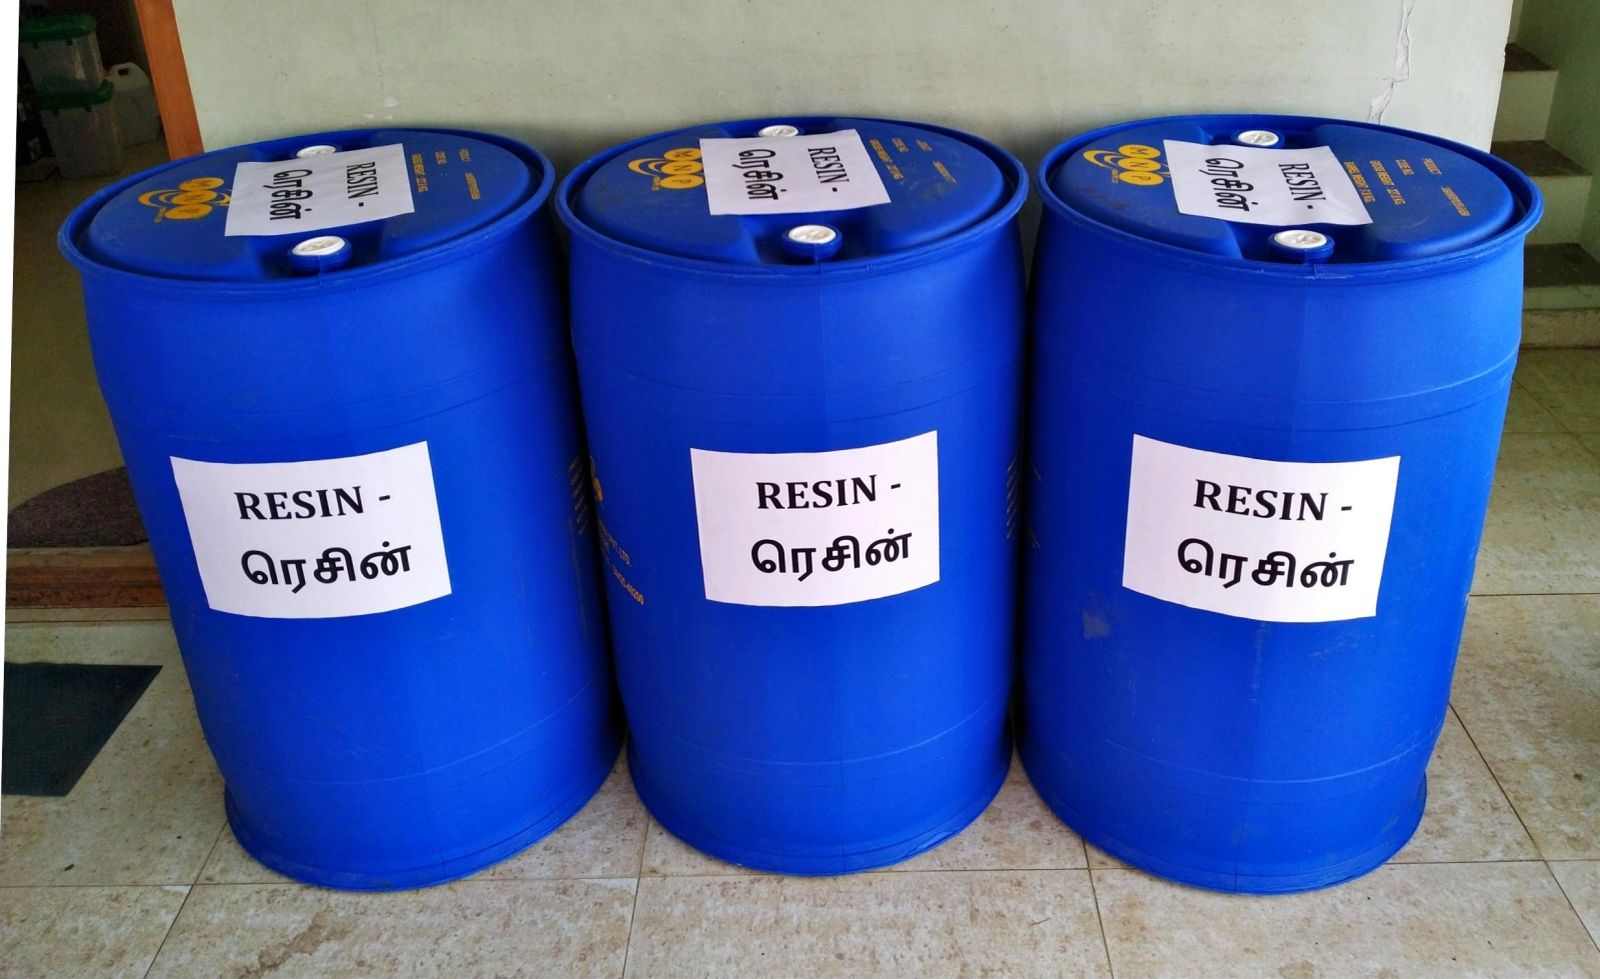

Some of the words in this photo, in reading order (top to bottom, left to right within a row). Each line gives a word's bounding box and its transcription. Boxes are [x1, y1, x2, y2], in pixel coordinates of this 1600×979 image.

[346, 161, 379, 203] RESIN
[731, 148, 788, 201] ரெசின்
[807, 146, 849, 184] RESIN
[1199, 157, 1260, 212] ரெசின்
[1278, 163, 1327, 202] RESIN
[262, 168, 315, 221] ரெசின்
[233, 486, 365, 520] RESIN
[755, 475, 877, 510] RESIN
[1193, 479, 1328, 521] RESIN
[241, 541, 412, 594] ரெசின்
[751, 528, 913, 582] ரெசின்
[1177, 538, 1355, 589] ரெசின்
